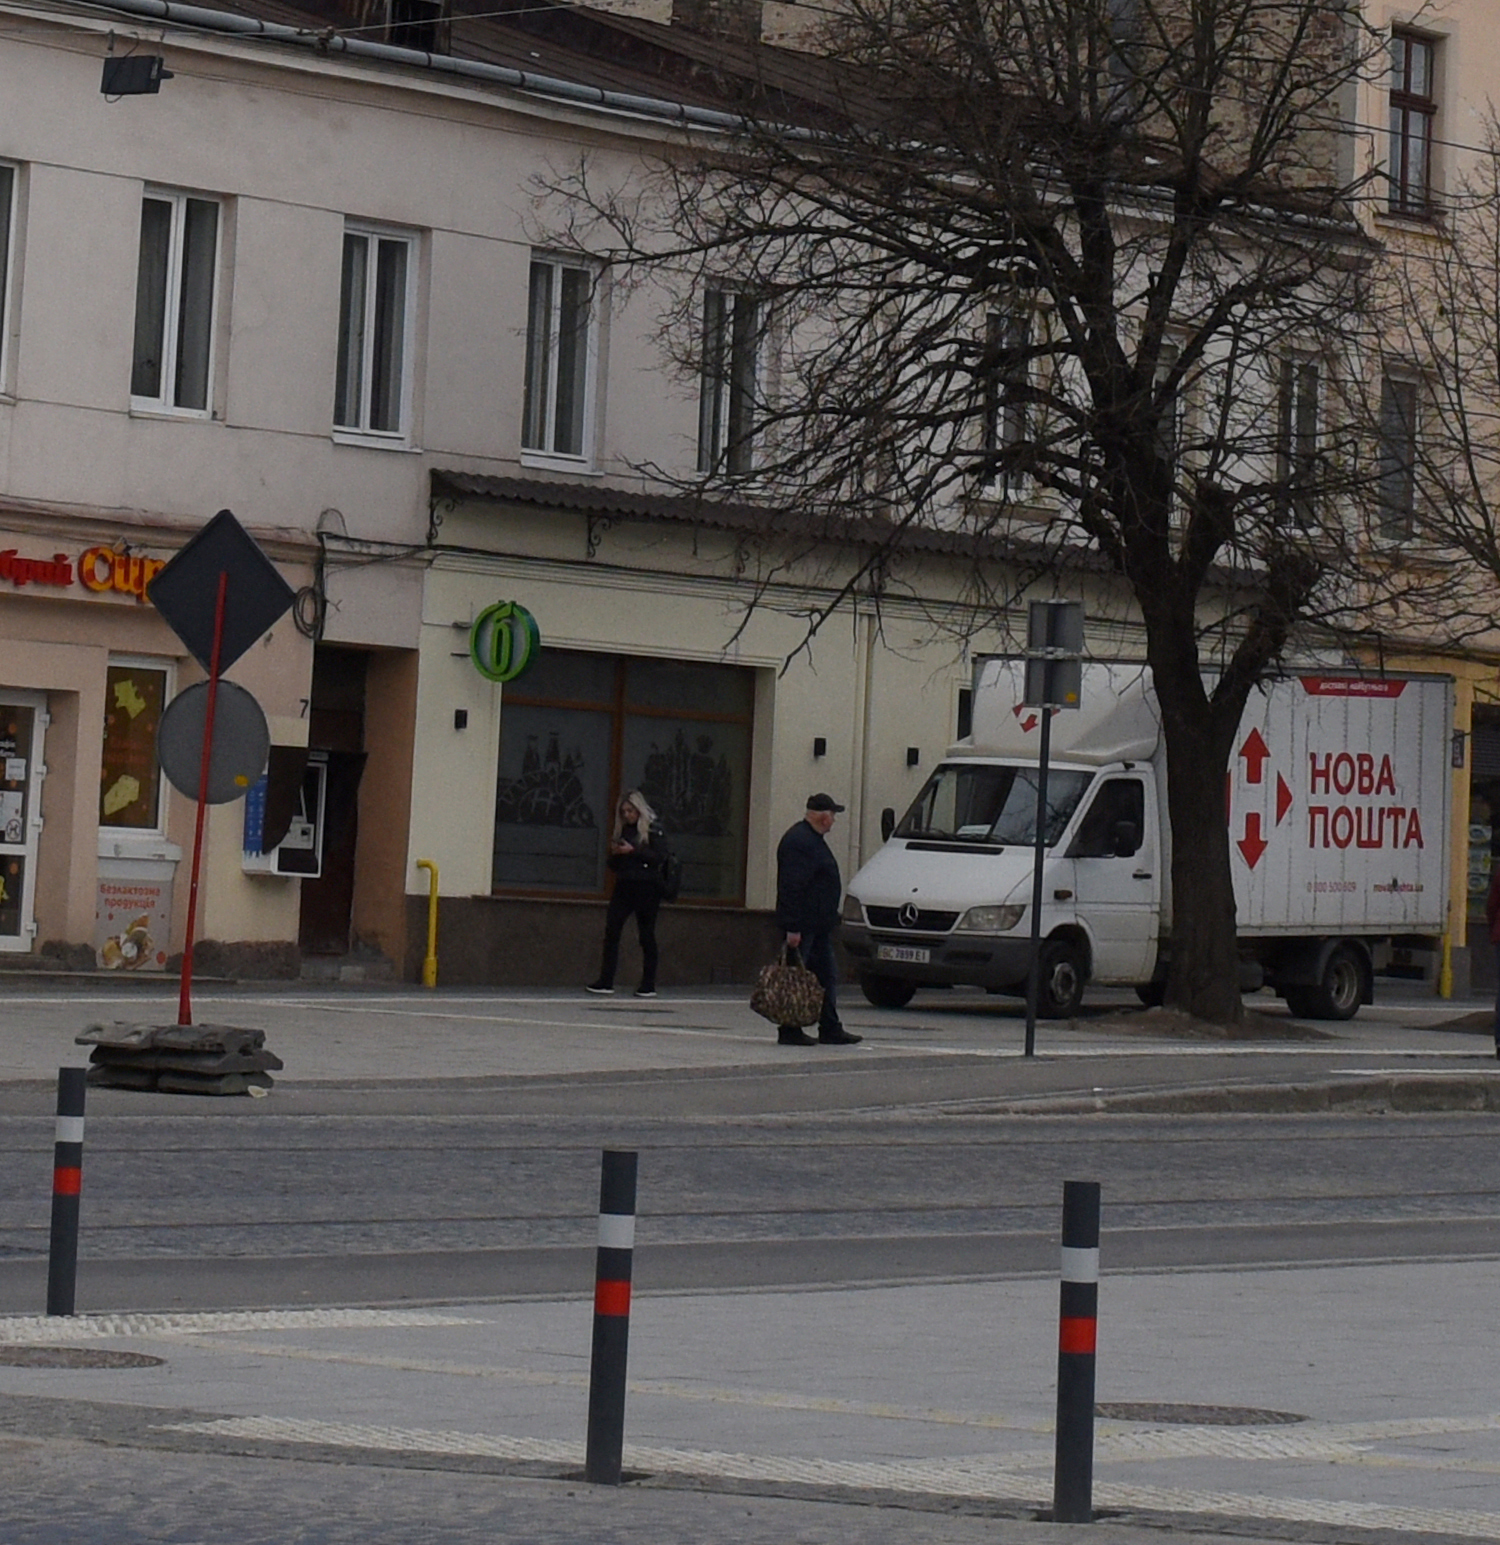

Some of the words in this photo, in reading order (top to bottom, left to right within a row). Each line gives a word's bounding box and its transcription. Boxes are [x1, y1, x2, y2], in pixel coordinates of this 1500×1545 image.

[300, 698, 309, 719] 7
[1309, 752, 1397, 795] НОВА
[1308, 806, 1424, 849] ПОШТА
